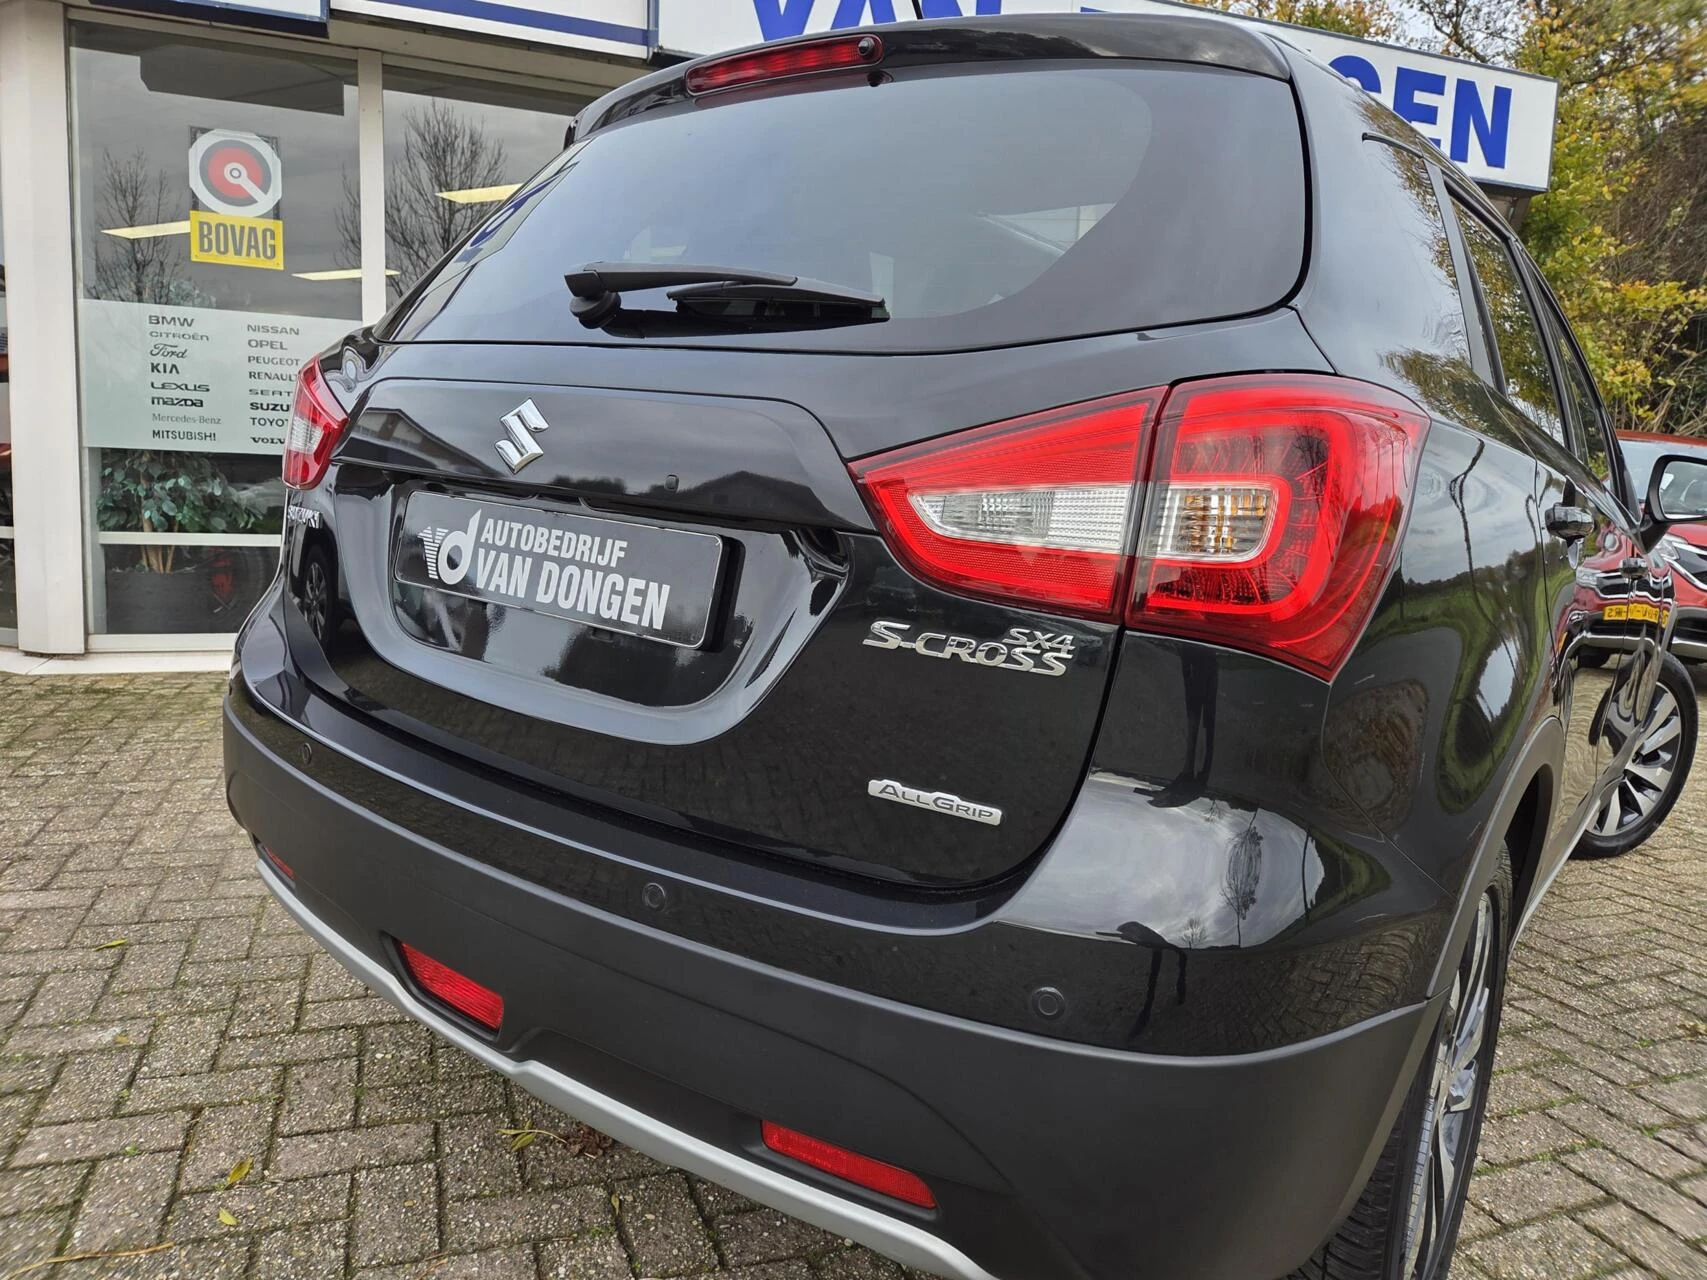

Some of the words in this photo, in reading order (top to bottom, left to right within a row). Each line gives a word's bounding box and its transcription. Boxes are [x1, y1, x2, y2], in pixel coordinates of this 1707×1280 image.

[198, 220, 277, 261] BOVAG
[148, 314, 195, 327] BMW
[247, 323, 300, 336] NISSAN
[149, 342, 188, 359] Ford
[247, 338, 289, 351] OPEL
[247, 355, 300, 367] PEUGEOT
[150, 361, 180, 375] KIA
[151, 381, 210, 393] LEXUS
[249, 401, 291, 413] SUZU
[152, 412, 222, 425] Mercedes-Benz
[152, 429, 217, 441] MITSUBISHI
[480, 518, 628, 568] AUTOBEDRIJF
[475, 547, 532, 599] VAN
[535, 561, 671, 631] DONGEN
[1002, 627, 1076, 655] SX4
[862, 620, 1074, 677] S-CROSS
